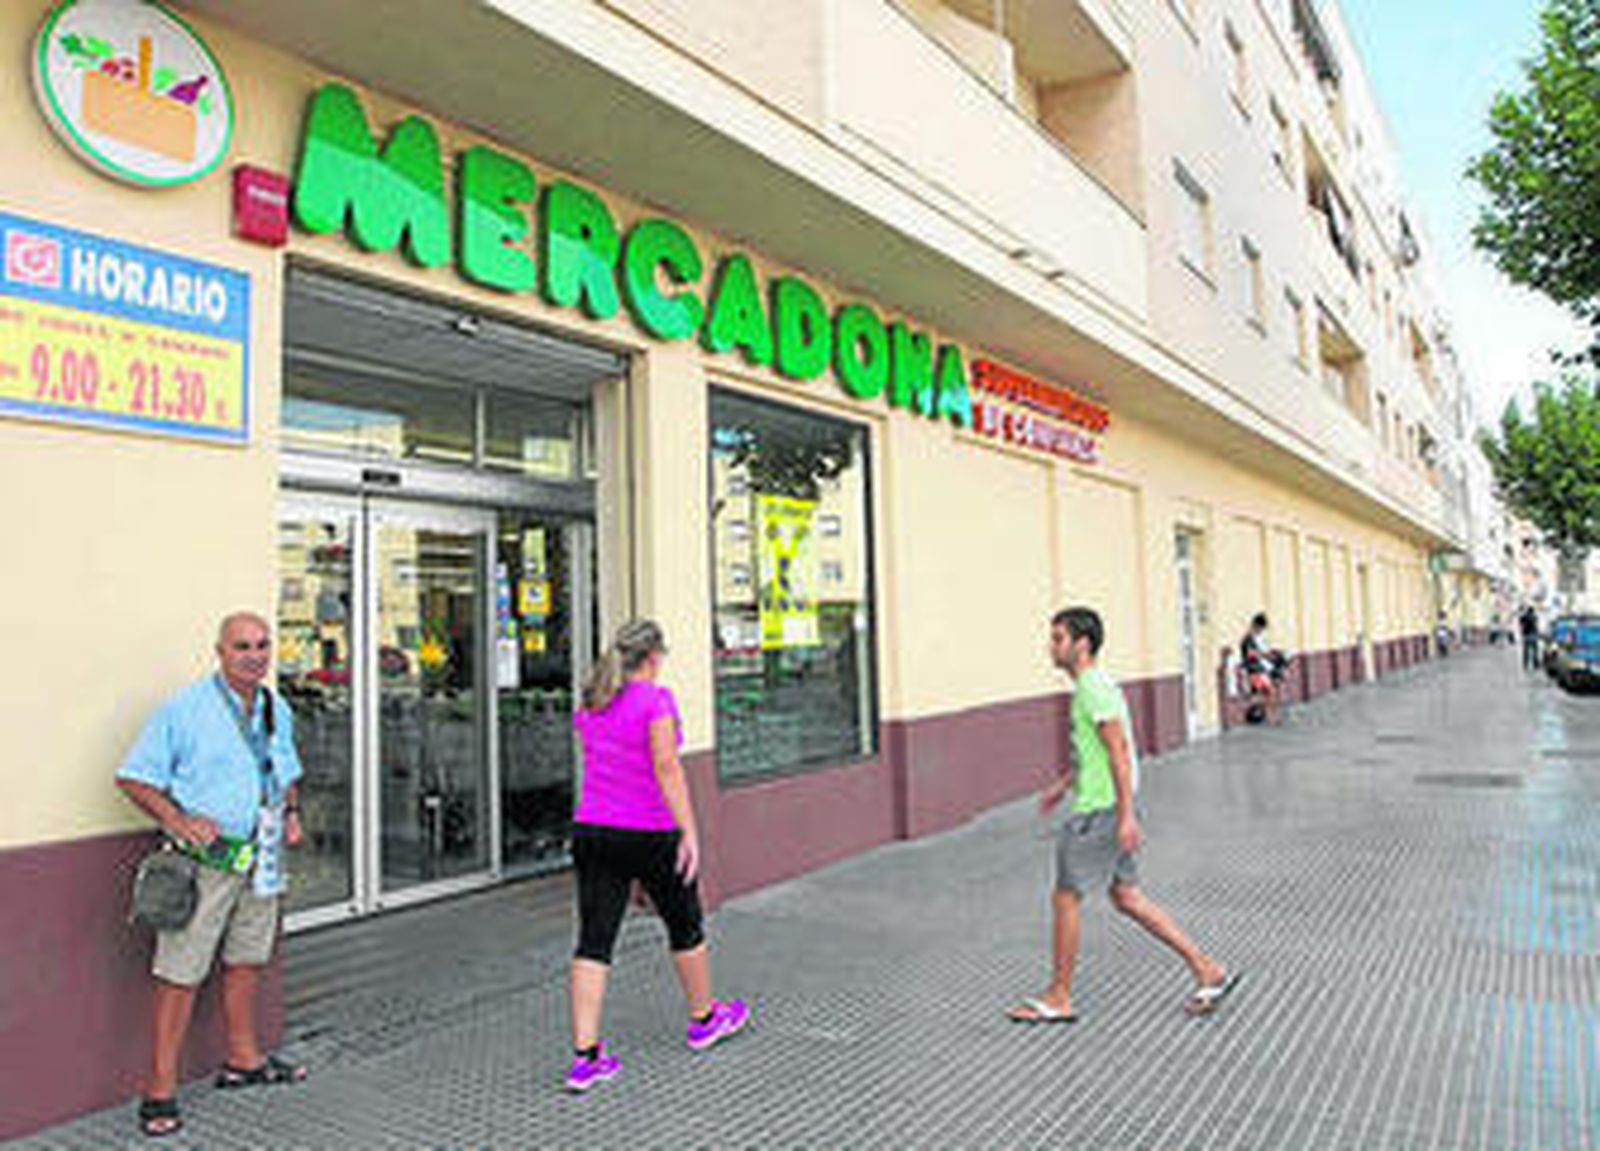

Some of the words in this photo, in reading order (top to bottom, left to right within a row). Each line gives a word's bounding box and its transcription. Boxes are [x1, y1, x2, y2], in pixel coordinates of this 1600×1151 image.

[71, 247, 227, 322] HORARIO
[294, 82, 973, 428] MERCADONA
[31, 343, 98, 404] 9.00
[129, 358, 206, 421] 21.30
